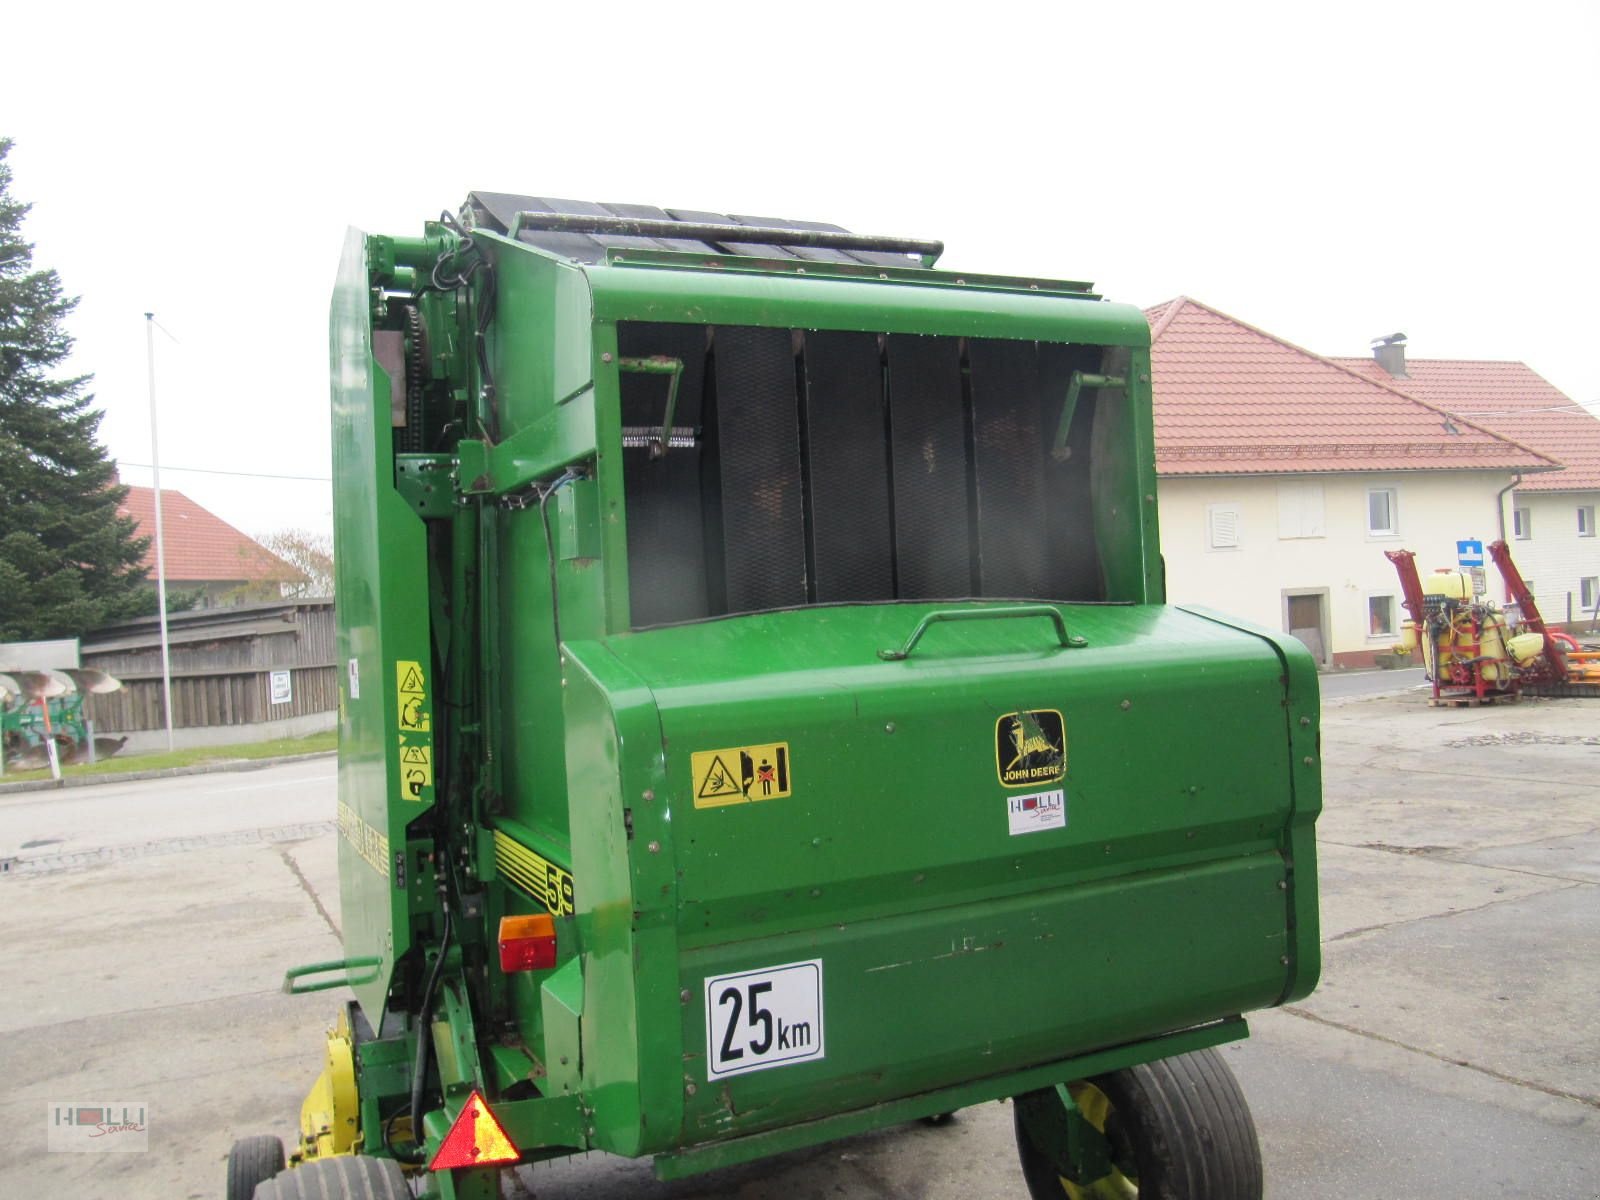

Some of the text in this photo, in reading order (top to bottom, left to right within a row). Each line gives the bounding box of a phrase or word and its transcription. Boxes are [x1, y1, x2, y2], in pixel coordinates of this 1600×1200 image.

[1003, 766, 1060, 781] JOHN DEERE
[719, 981, 811, 1062] 25 km
